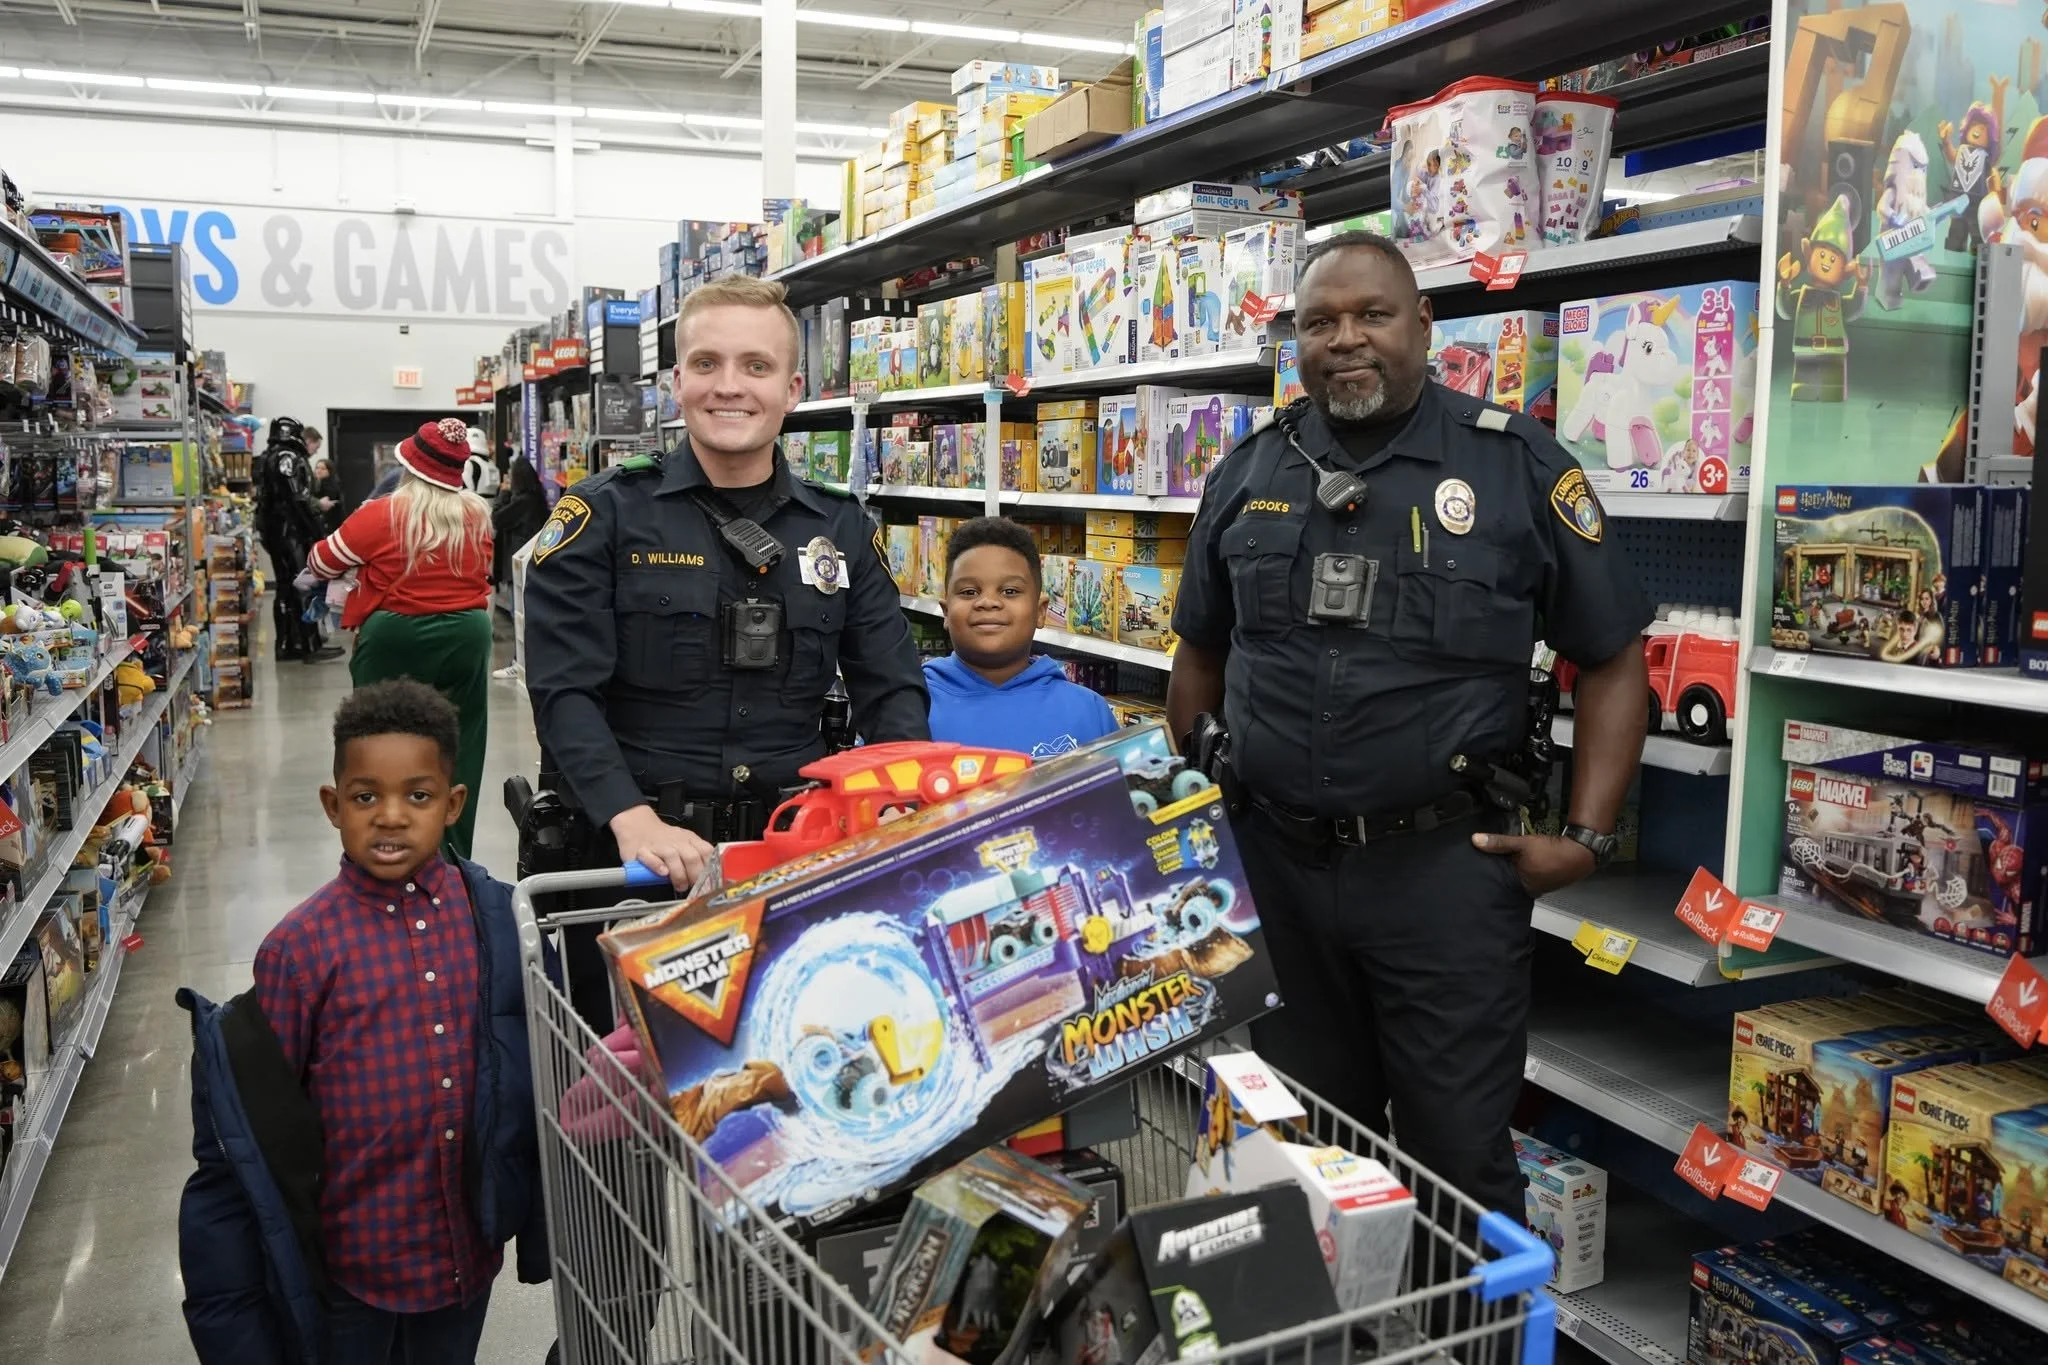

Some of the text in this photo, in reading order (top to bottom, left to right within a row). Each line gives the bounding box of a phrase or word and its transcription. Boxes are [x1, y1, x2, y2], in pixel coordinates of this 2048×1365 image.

[1557, 156, 1588, 171] 10 9
[1196, 194, 1249, 208] RAIL RACERS
[260, 214, 313, 308] &
[333, 217, 570, 317] GAMES
[1491, 276, 1514, 286] Rollback
[1565, 308, 1588, 320] MEGA
[1564, 319, 1588, 333] BLOKS
[554, 346, 577, 360] LEGO
[398, 370, 419, 385] EXIT
[528, 383, 537, 458] PLAY LASTS FOREVER
[1630, 470, 1649, 489] 26
[1702, 464, 1725, 489] 3+
[1565, 484, 1587, 507] POLICE
[1800, 491, 1825, 510] Harry
[1824, 489, 1852, 508] Potter
[1250, 500, 1290, 513] COOKS
[1776, 520, 1787, 530] 8+
[631, 553, 704, 566] D. WILLIAMS
[1801, 727, 1828, 743] MARVEL
[1792, 778, 1868, 809] LEGO MARVEL
[1788, 802, 1800, 813] 9+
[1783, 866, 1796, 876] 393
[1680, 902, 1720, 941] Rollback
[2020, 901, 2033, 934] MARVEL
[1738, 930, 1767, 945] Rollback
[643, 933, 752, 989] MONSTER
[1591, 952, 1620, 967] Clearance
[680, 962, 730, 994] JAM
[1061, 970, 1205, 1066] MONSTER
[1991, 995, 2032, 1042] Rollback
[1087, 1004, 1195, 1079] WASH
[1755, 1033, 1774, 1052] ONE
[1774, 1040, 1796, 1060] PIECE
[1896, 1092, 1970, 1134] LEGO ONE PIECE
[1679, 1158, 1719, 1195] Rollback
[1736, 1185, 1765, 1203] Rollback
[1712, 1275, 1733, 1298] Harry
[1732, 1286, 1756, 1311] Potter
